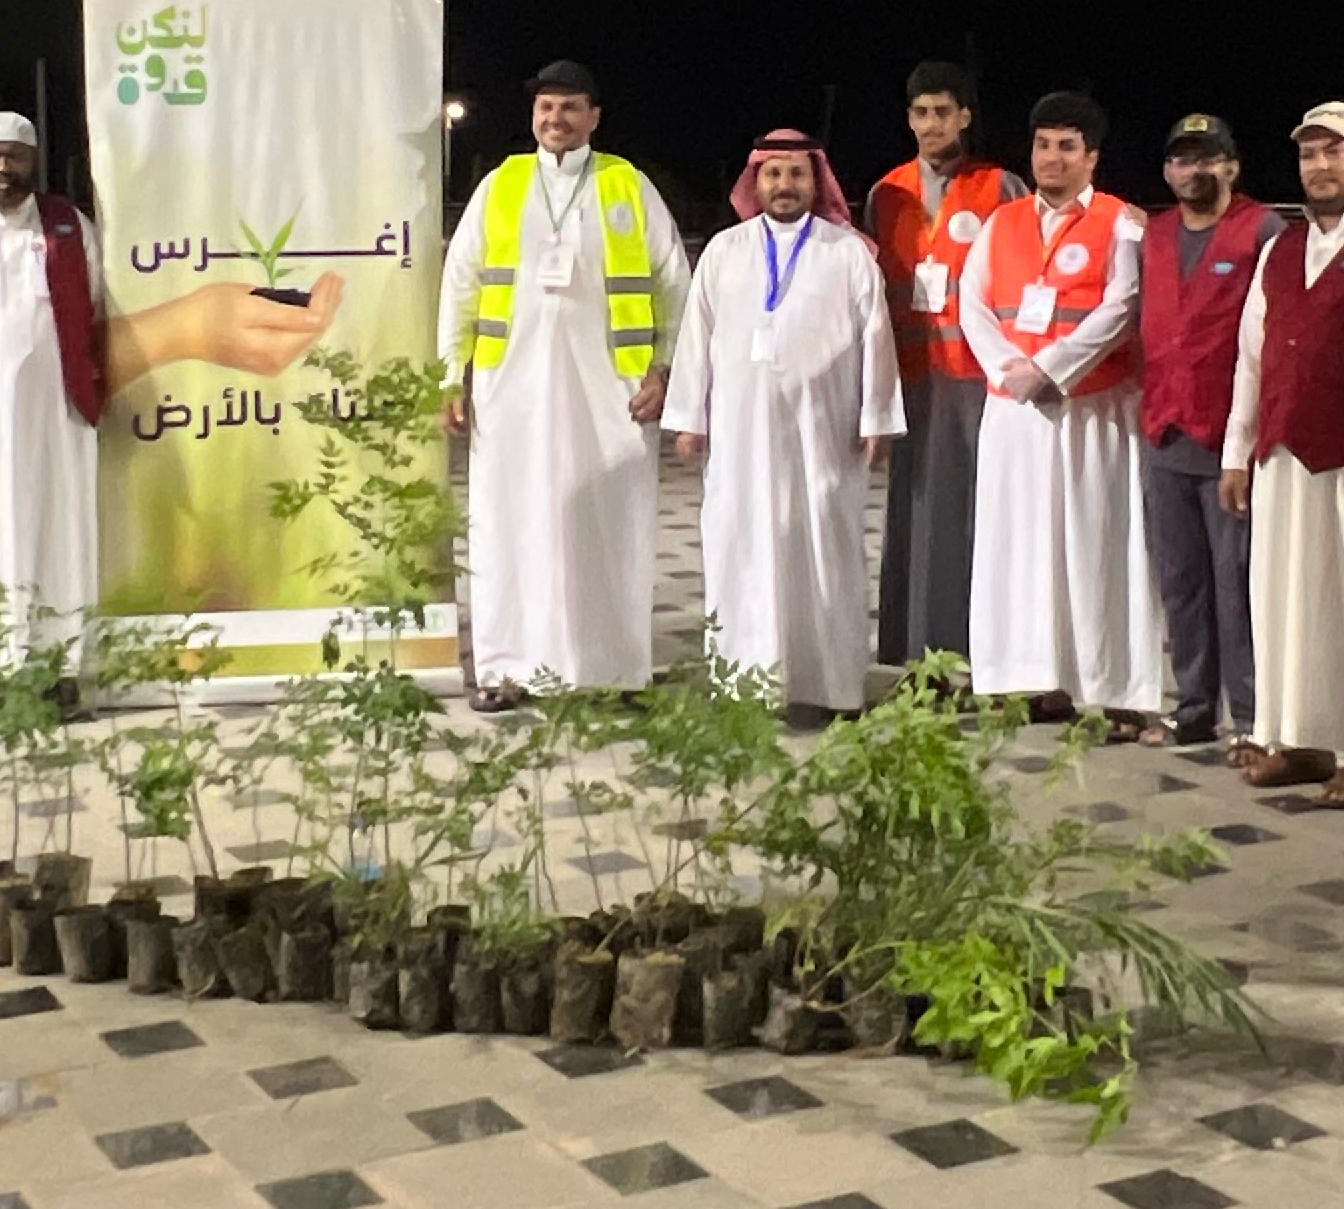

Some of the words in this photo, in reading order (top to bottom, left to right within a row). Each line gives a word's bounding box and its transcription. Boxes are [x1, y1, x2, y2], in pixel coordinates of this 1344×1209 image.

[116, 4, 209, 56] لنكن
[117, 54, 208, 105] قدوة
[132, 386, 282, 442] بالأرض
